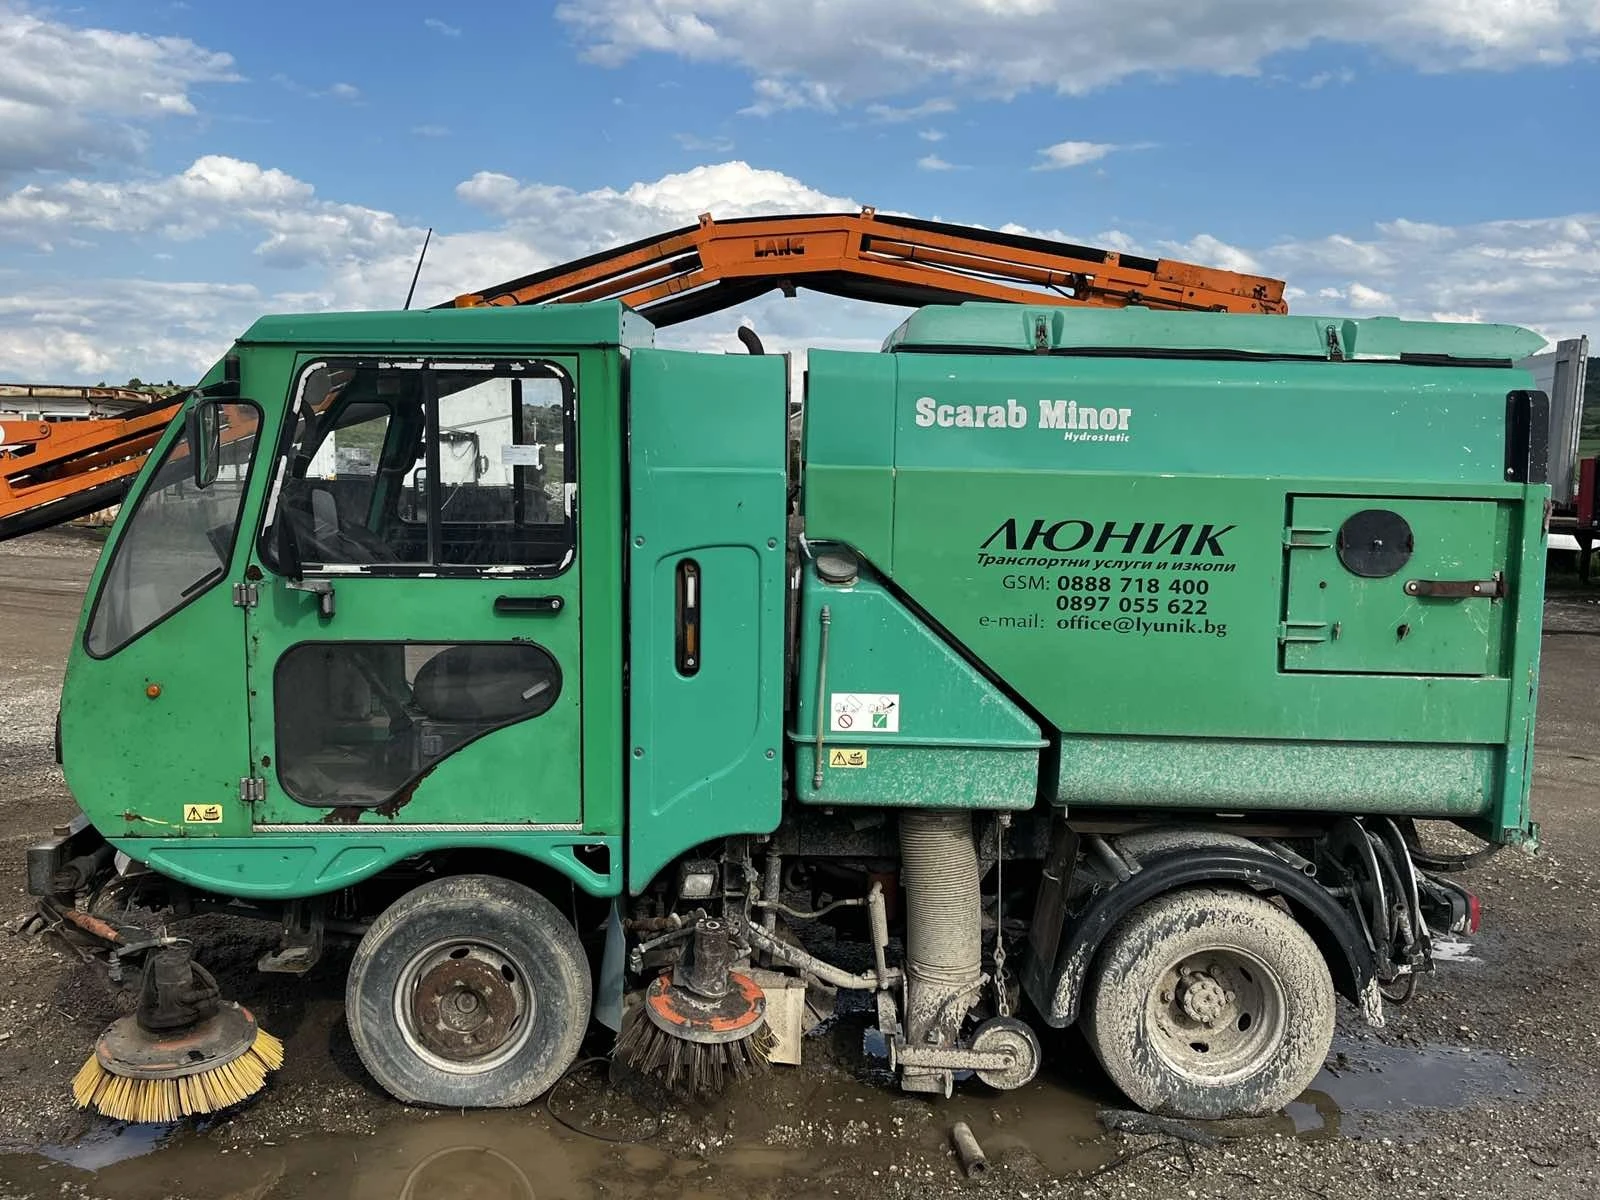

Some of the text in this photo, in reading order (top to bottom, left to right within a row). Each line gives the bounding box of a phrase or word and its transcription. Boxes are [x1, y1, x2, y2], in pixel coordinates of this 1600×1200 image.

[915, 397, 1132, 430] Scarab Minor
[1064, 432, 1130, 443] Hydrostatic
[980, 518, 1238, 556] ЛЮНИК
[977, 553, 1236, 573] Транспортни услуги и изкопи
[1002, 575, 1209, 595] GSM: 0888 718 400
[1056, 595, 1208, 615] 0897 055 622
[979, 613, 1227, 637] e-mail: office@lyunik.bg
